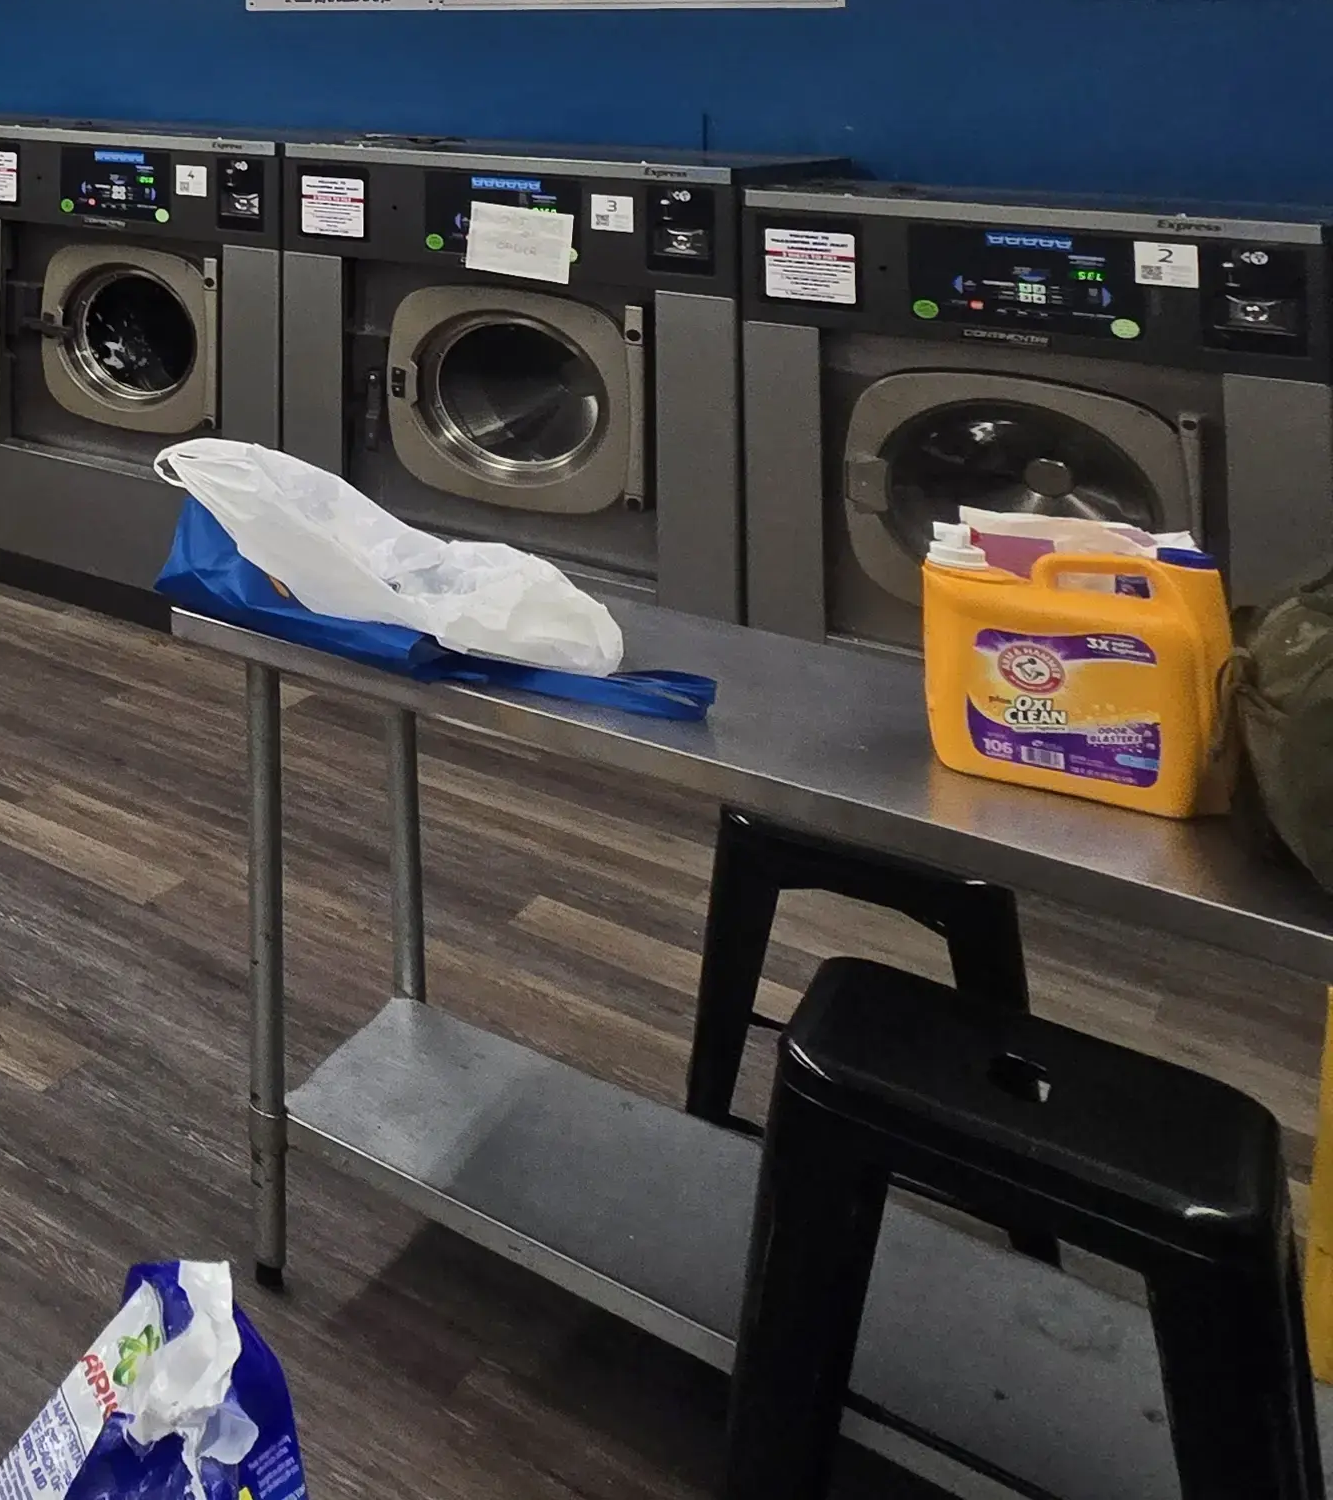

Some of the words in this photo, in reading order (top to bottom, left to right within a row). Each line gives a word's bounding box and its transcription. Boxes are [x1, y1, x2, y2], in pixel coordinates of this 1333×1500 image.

[187, 171, 195, 180] 4
[644, 167, 687, 178] Express
[607, 200, 618, 213] 3
[1157, 219, 1222, 232] Express
[1157, 248, 1173, 264] 2
[1086, 637, 1110, 652] 3X
[1016, 695, 1053, 712] OXI
[1004, 707, 1067, 724] CLEAN
[1098, 727, 1128, 735] ODOR
[1090, 735, 1140, 743] BLASTERS
[21, 1433, 37, 1467] FIRST
[31, 1467, 48, 1491] AID
